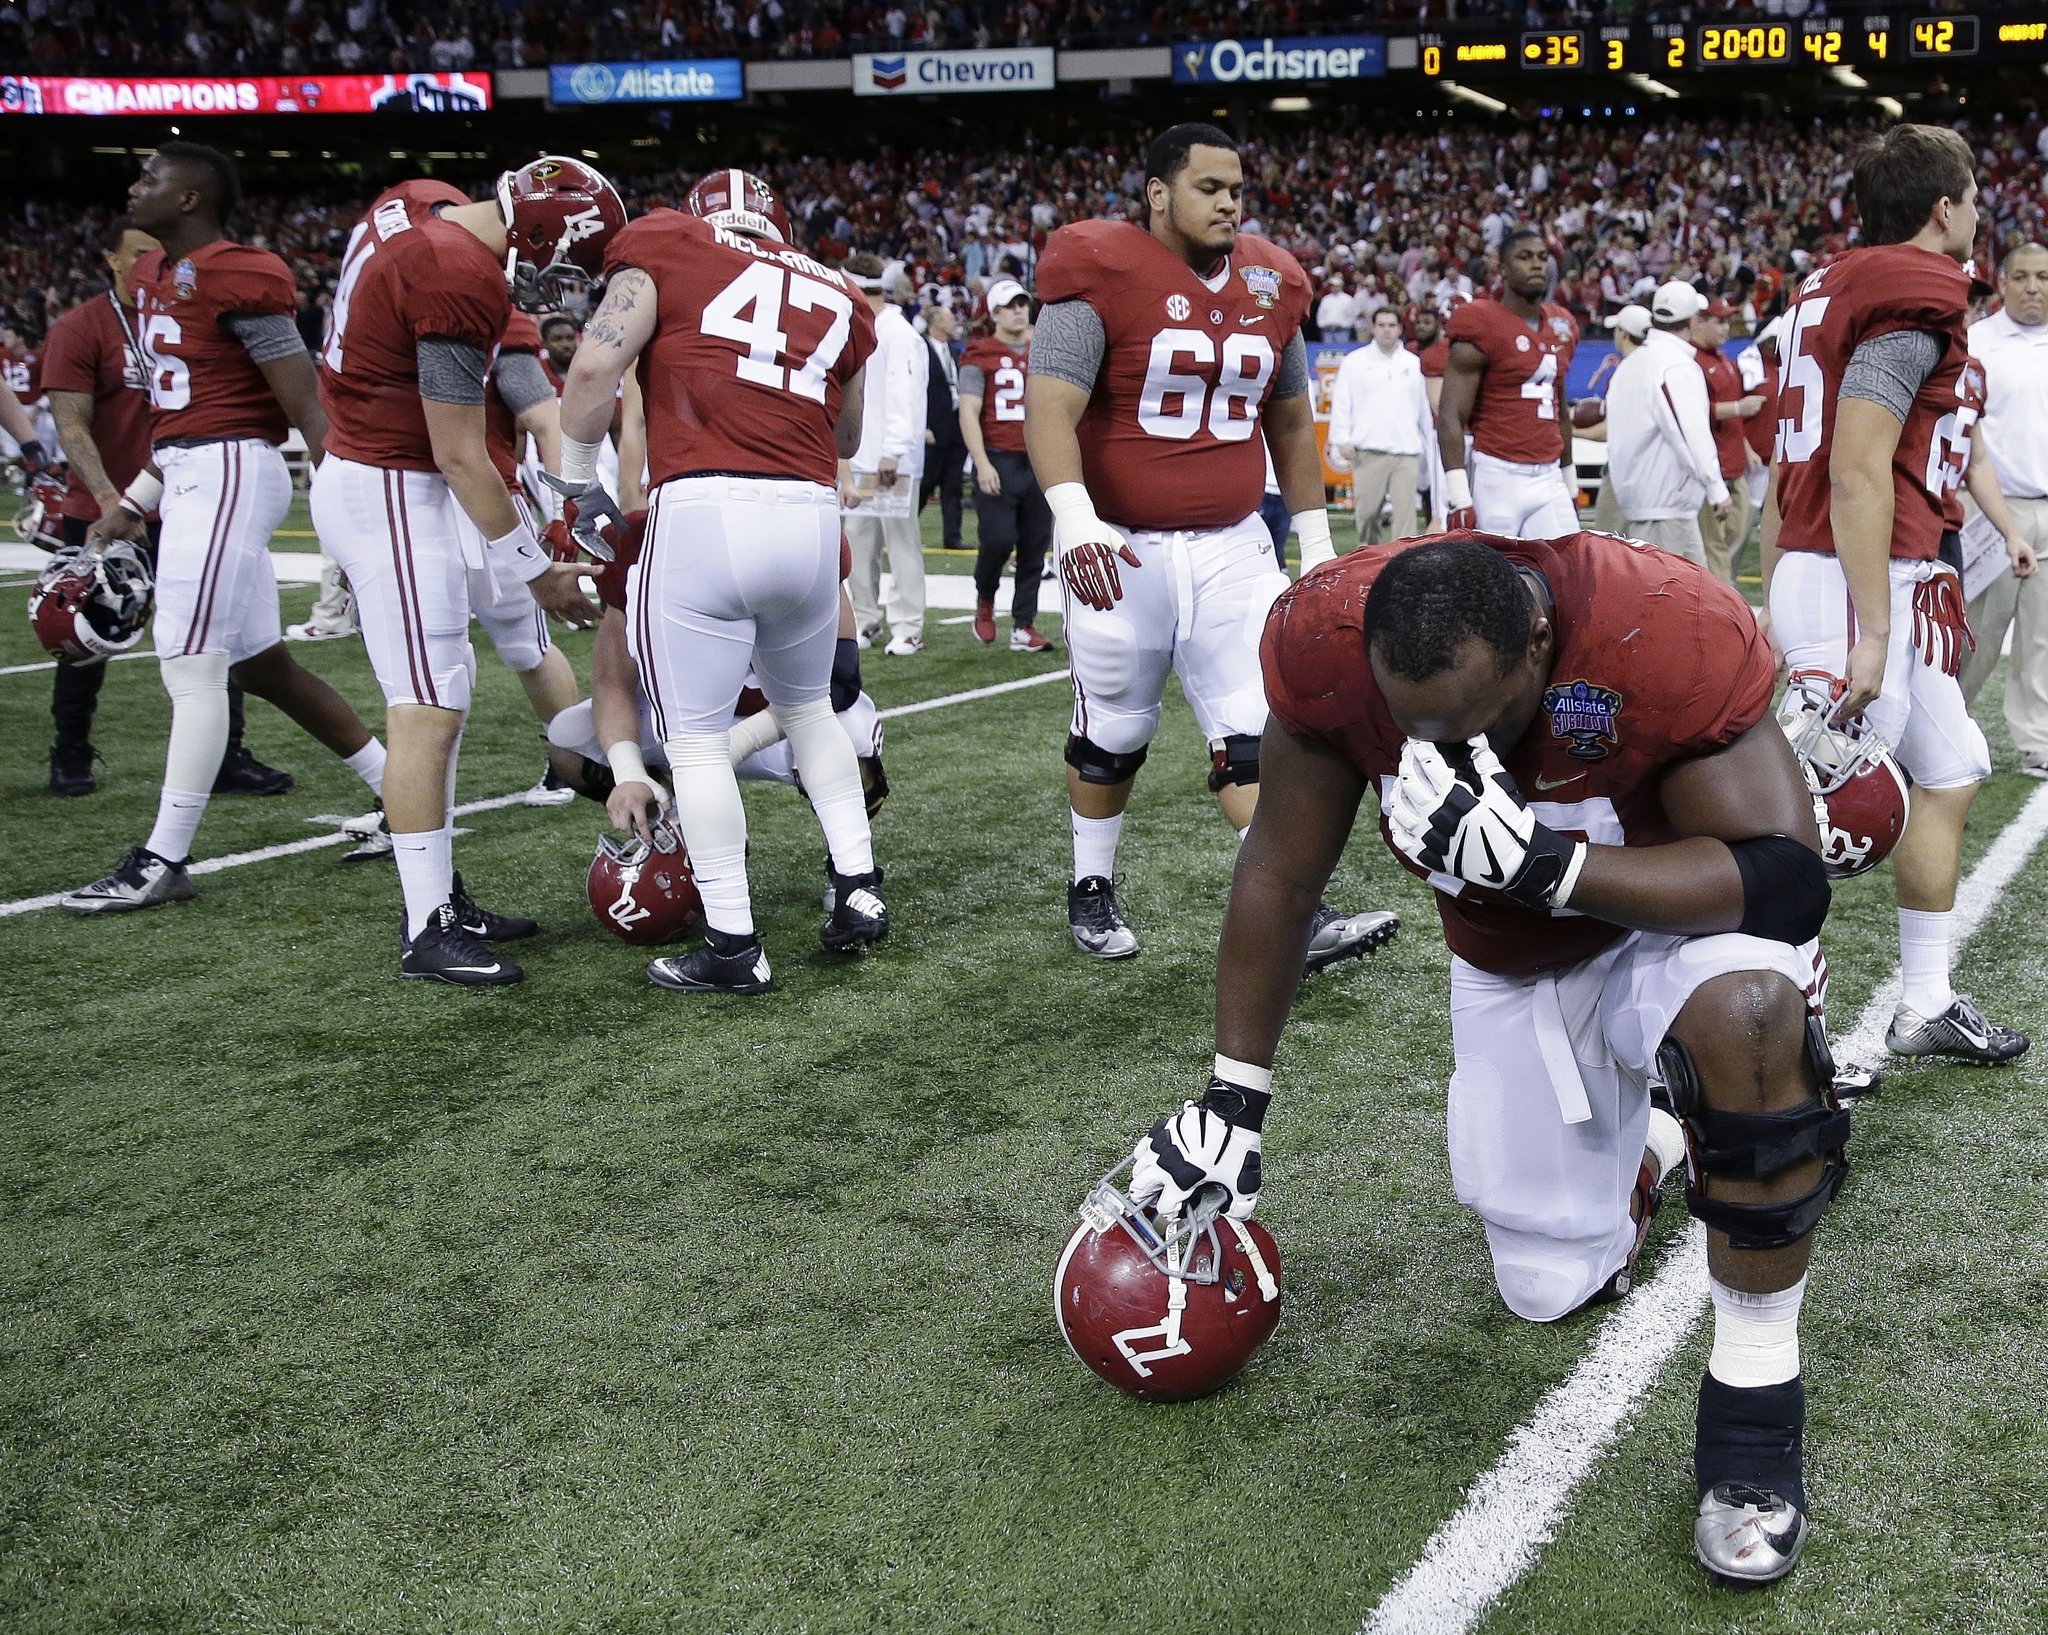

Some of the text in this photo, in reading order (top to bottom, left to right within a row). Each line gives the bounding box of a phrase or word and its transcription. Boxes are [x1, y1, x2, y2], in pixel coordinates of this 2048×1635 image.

[1703, 27, 1786, 60] 20:00
[1804, 32, 1841, 63] 42
[1868, 32, 1887, 59] 4
[1915, 21, 1953, 52] 42
[1210, 38, 1366, 82] Ochsner
[1424, 46, 1440, 75] 0
[1607, 40, 1623, 69] 3
[1667, 38, 1685, 67] 2
[616, 67, 717, 99] Allstate
[919, 57, 1034, 84] Chevron
[64, 82, 259, 113] CHAMPIONS
[563, 205, 605, 242] 14
[1166, 294, 1191, 321] SEC
[700, 260, 853, 406] 47
[1138, 327, 1275, 441] 68
[1521, 353, 1558, 419] 4
[1554, 697, 1607, 715] Allstate
[1112, 1316, 1192, 1378] 77
